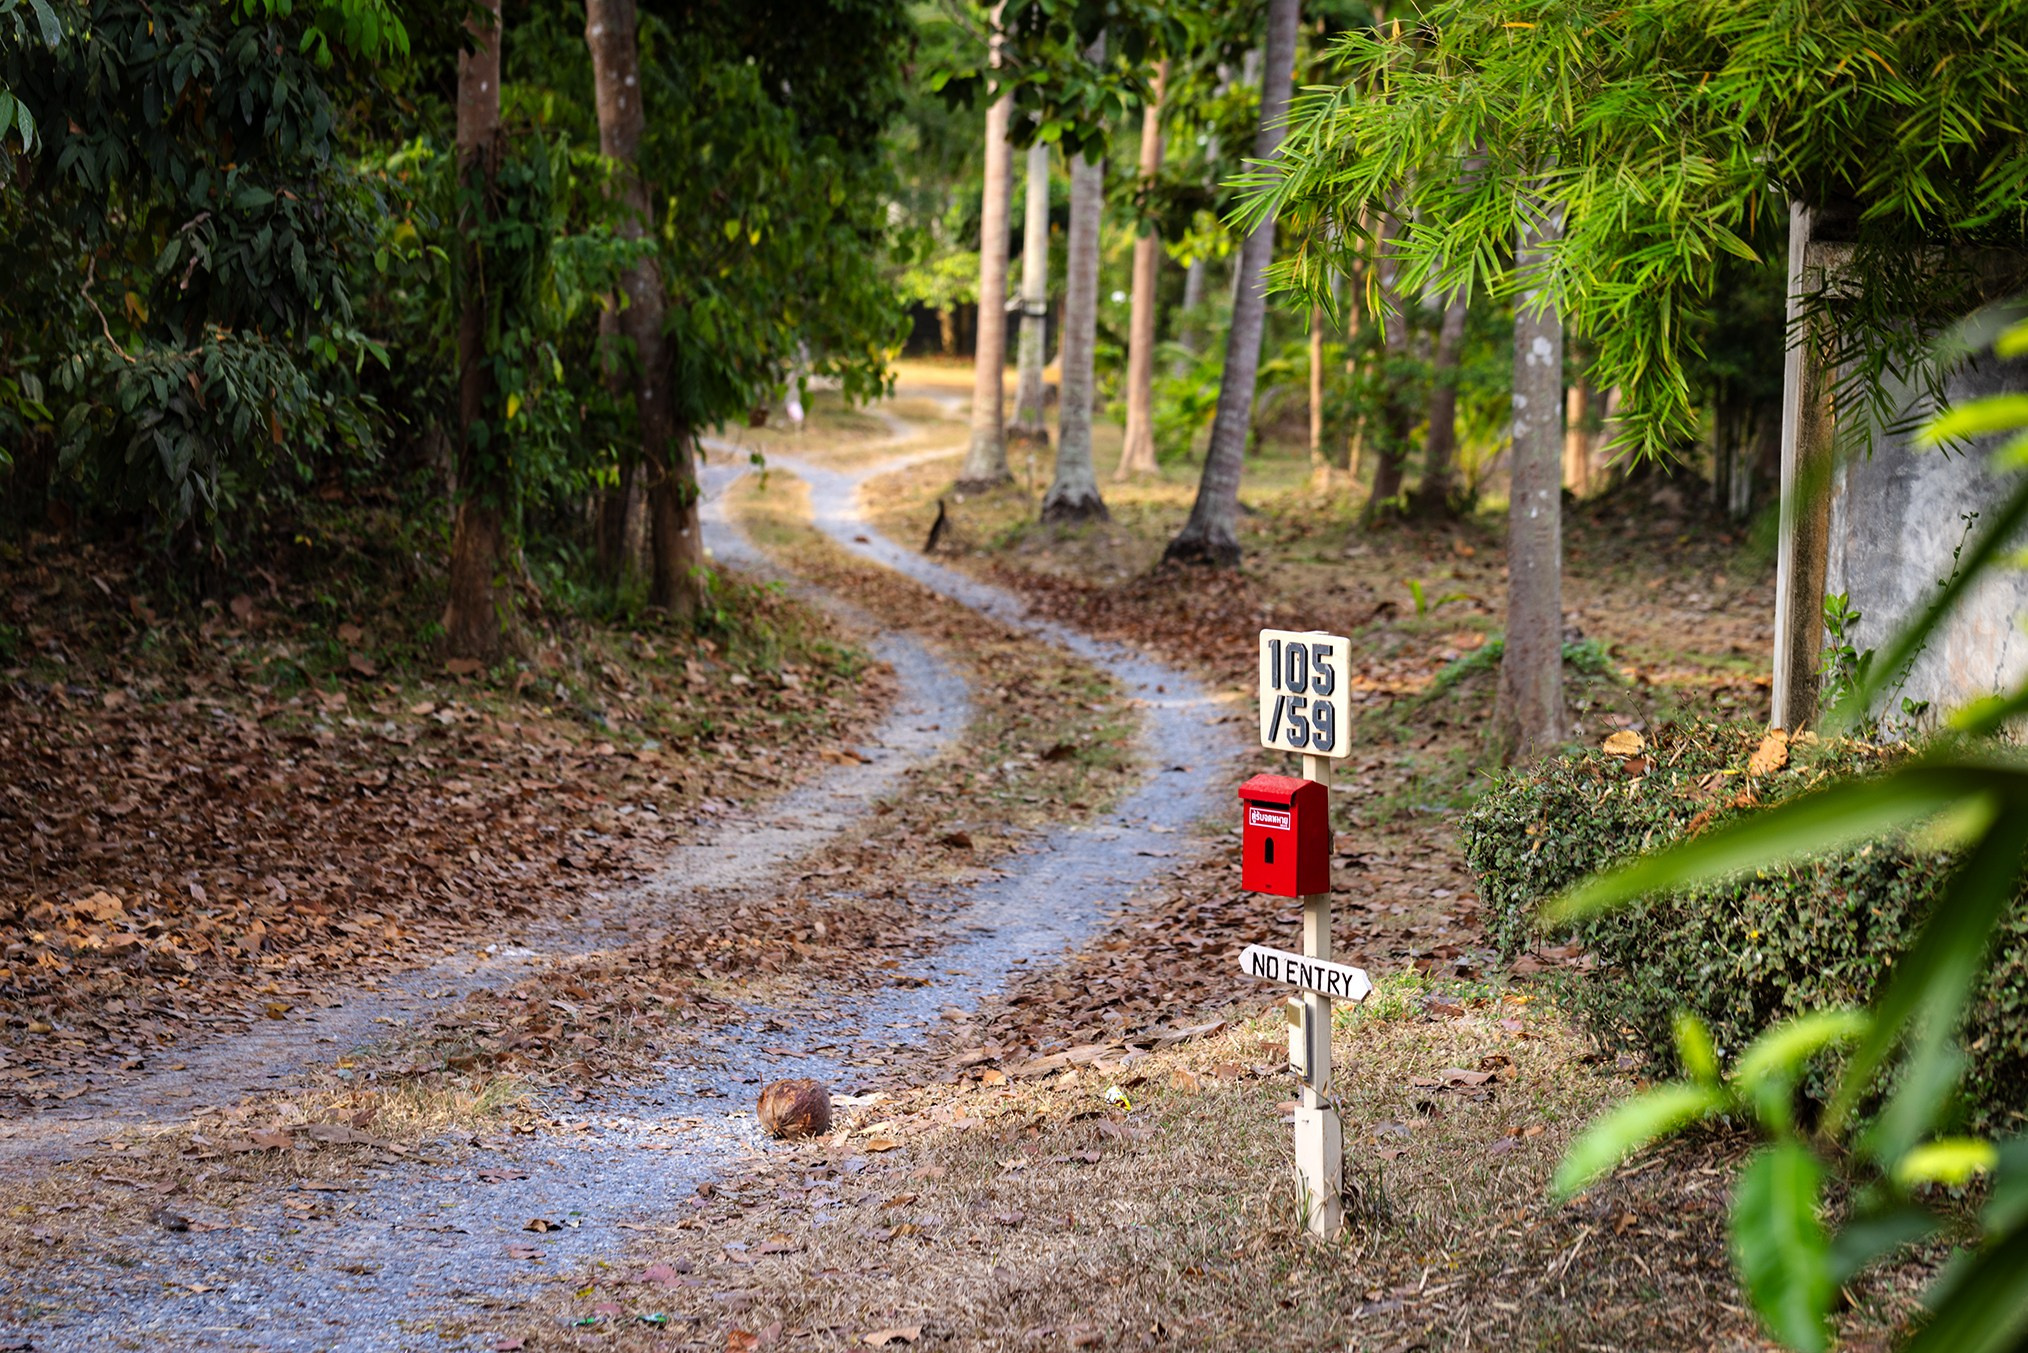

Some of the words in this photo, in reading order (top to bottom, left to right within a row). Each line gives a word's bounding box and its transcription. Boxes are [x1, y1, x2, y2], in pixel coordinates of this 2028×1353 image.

[1268, 639, 1335, 696] 105
[1268, 695, 1335, 752] /59
[1253, 952, 1278, 980] NO
[1286, 960, 1353, 997] ENTRY
